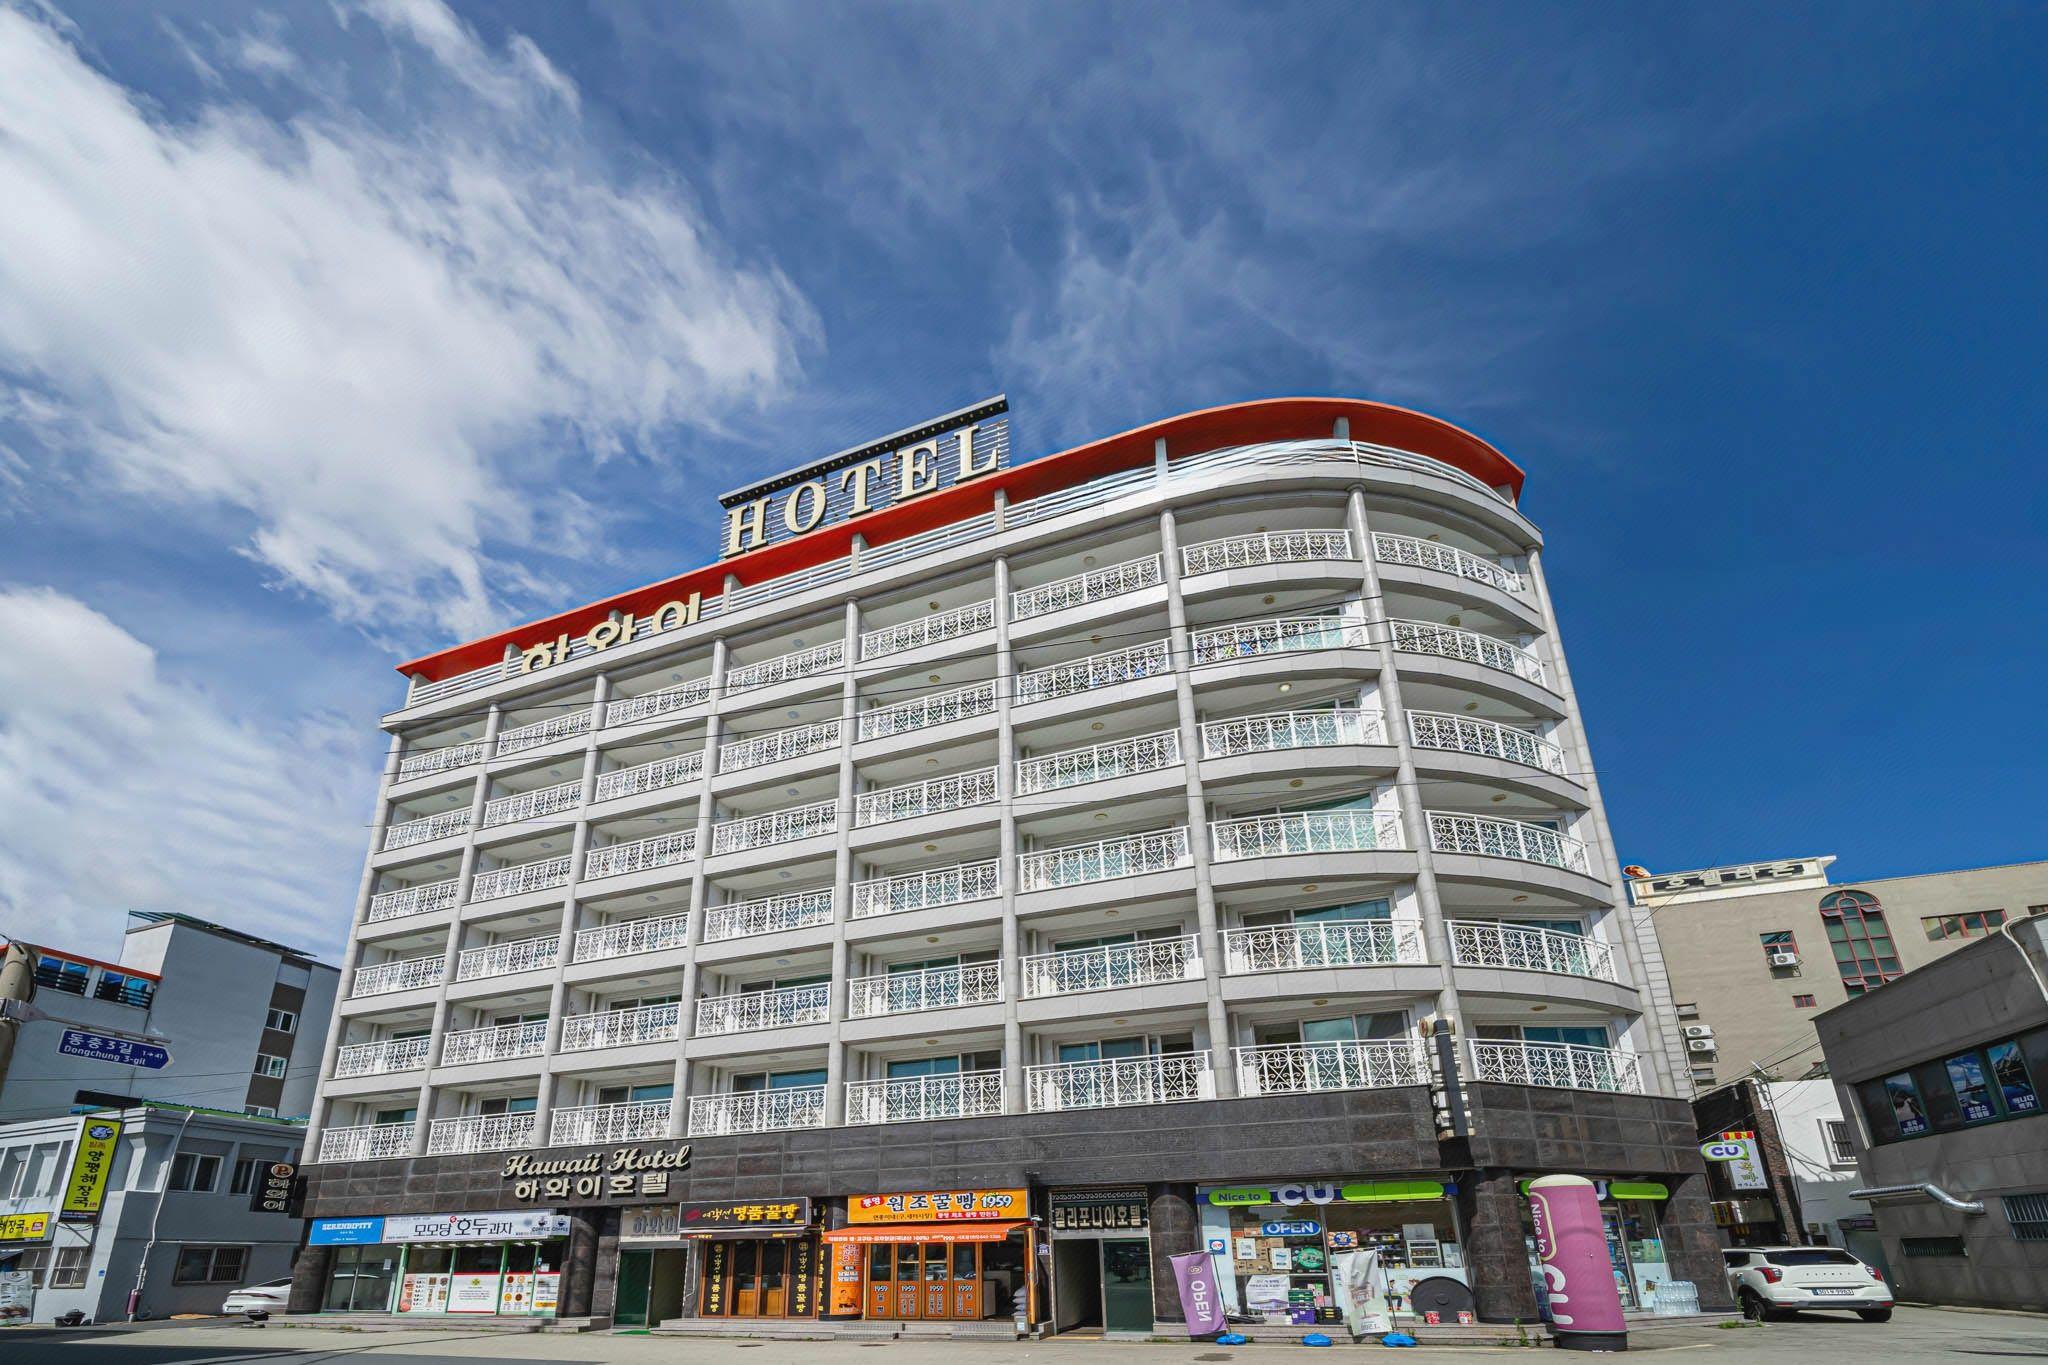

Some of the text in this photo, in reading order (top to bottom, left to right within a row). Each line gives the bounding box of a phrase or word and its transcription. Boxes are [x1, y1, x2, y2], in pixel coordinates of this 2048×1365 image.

[725, 424, 1001, 557] HOTEL
[521, 592, 702, 674] 하와이
[63, 1045, 120, 1062] Dongchung
[68, 1033, 133, 1054] 동충3길
[500, 1144, 690, 1177] Hawaii Hotel
[1711, 1146, 1739, 1156] CU
[73, 1150, 105, 1208] 양평해장국
[514, 1172, 668, 1199] 하와이호텔
[264, 1179, 290, 1210] 하와이
[981, 1194, 1013, 1209] 1959
[1218, 1184, 1335, 1206] Nice to CU
[702, 1203, 799, 1221] 여객선 명품꿀빵
[1055, 1205, 1141, 1228] 캘리포니아호텔
[322, 1222, 373, 1231] SERENDIPITY
[413, 1217, 513, 1236] 모모당 호두과자
[1266, 1222, 1314, 1234] OPEN
[1531, 1203, 1542, 1235] Nice
[1538, 1238, 1547, 1253] to
